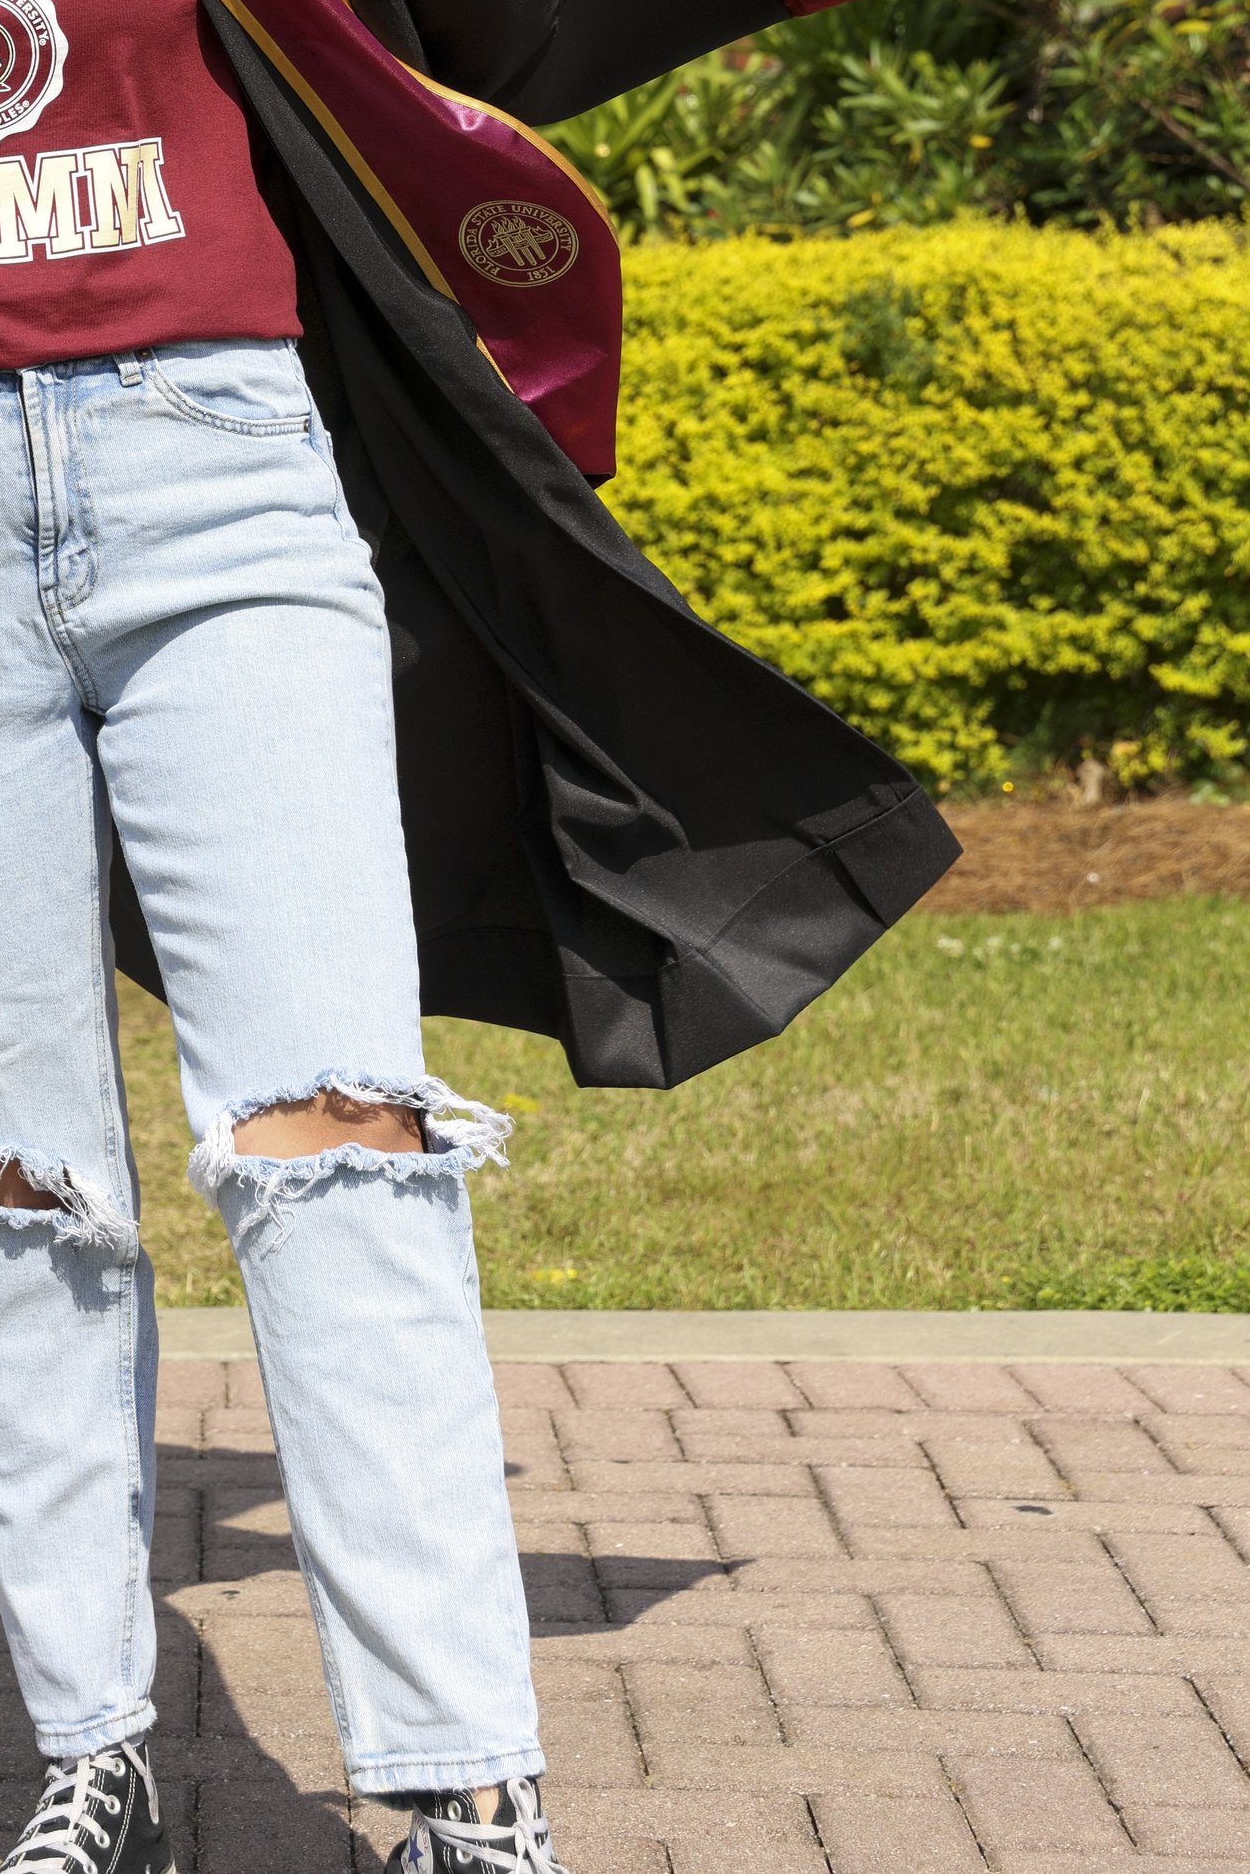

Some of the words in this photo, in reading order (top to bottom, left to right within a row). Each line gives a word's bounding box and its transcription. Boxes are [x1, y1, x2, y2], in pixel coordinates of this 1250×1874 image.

[471, 205, 507, 226] STATE
[511, 205, 572, 252] UNIVERSITY
[466, 228, 501, 276] FLORIDA
[527, 266, 555, 281] 1851
